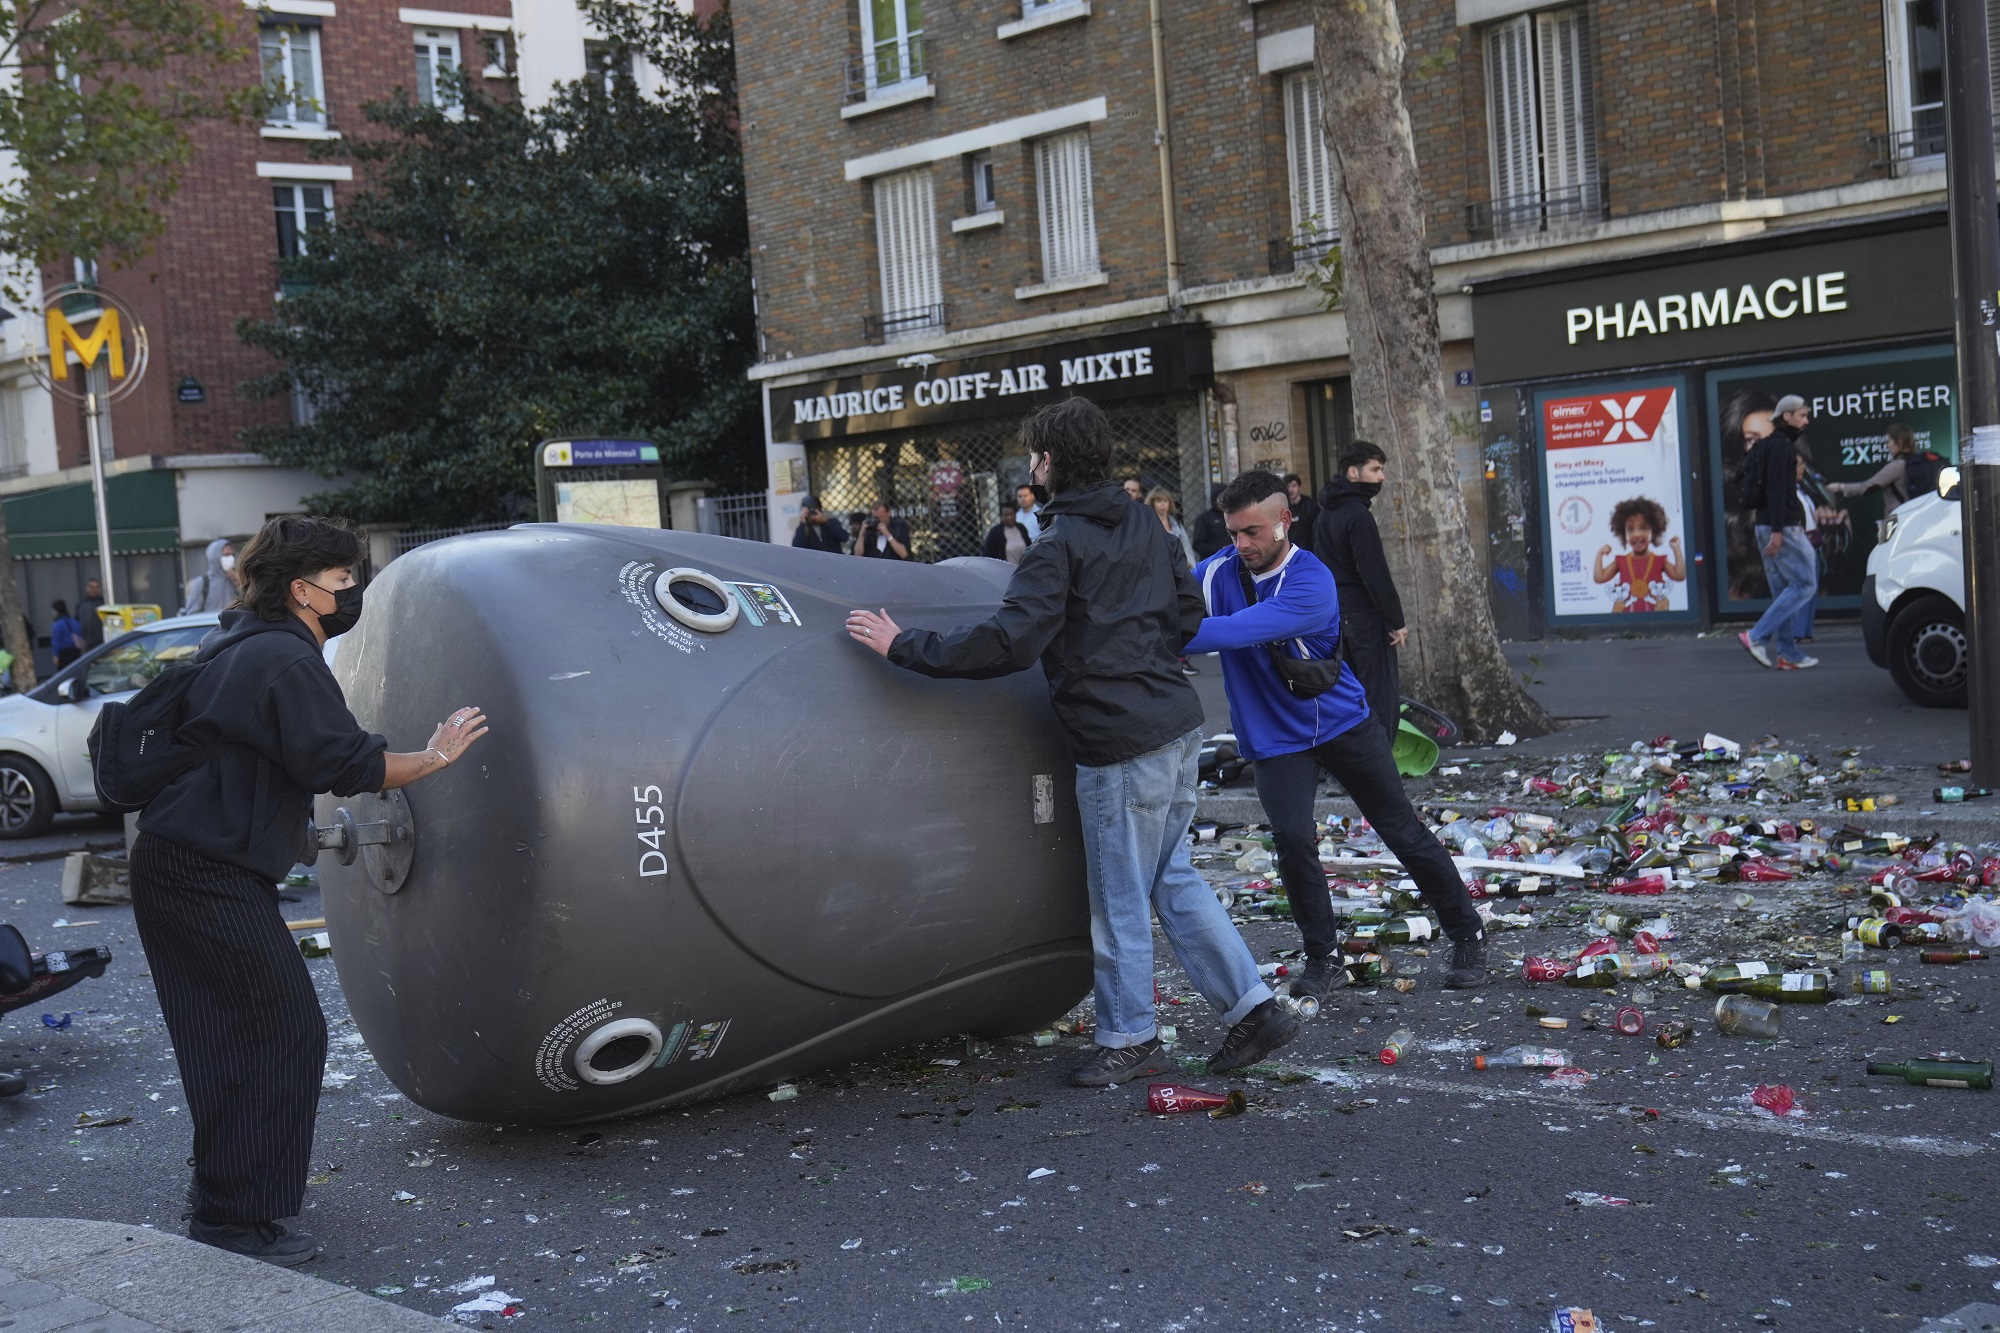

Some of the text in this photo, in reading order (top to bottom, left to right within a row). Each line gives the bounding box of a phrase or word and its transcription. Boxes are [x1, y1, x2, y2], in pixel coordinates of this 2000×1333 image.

[1567, 271, 1847, 344] PHARMACIE
[46, 307, 125, 380] M
[794, 347, 1153, 424] MAURICE COIFF-AIR MIXTE
[1460, 373, 1469, 385] 2
[1553, 405, 1585, 418] elmex
[1812, 384, 1950, 419] FURTERER
[574, 450, 593, 459] Porte
[594, 450, 603, 459] de
[604, 449, 637, 459] Montreuil
[1842, 445, 1872, 466] 2X
[1555, 479, 1596, 489] champions
[668, 639, 691, 654] POUR
[634, 785, 668, 877] D455
[549, 1022, 565, 1036] DES
[563, 997, 608, 1024] RIVERAINS
[556, 1026, 573, 1040] VOS
[571, 1001, 623, 1028] BOUTEILLES
[565, 1033, 576, 1043] ET
[579, 1011, 613, 1031] HEURES
